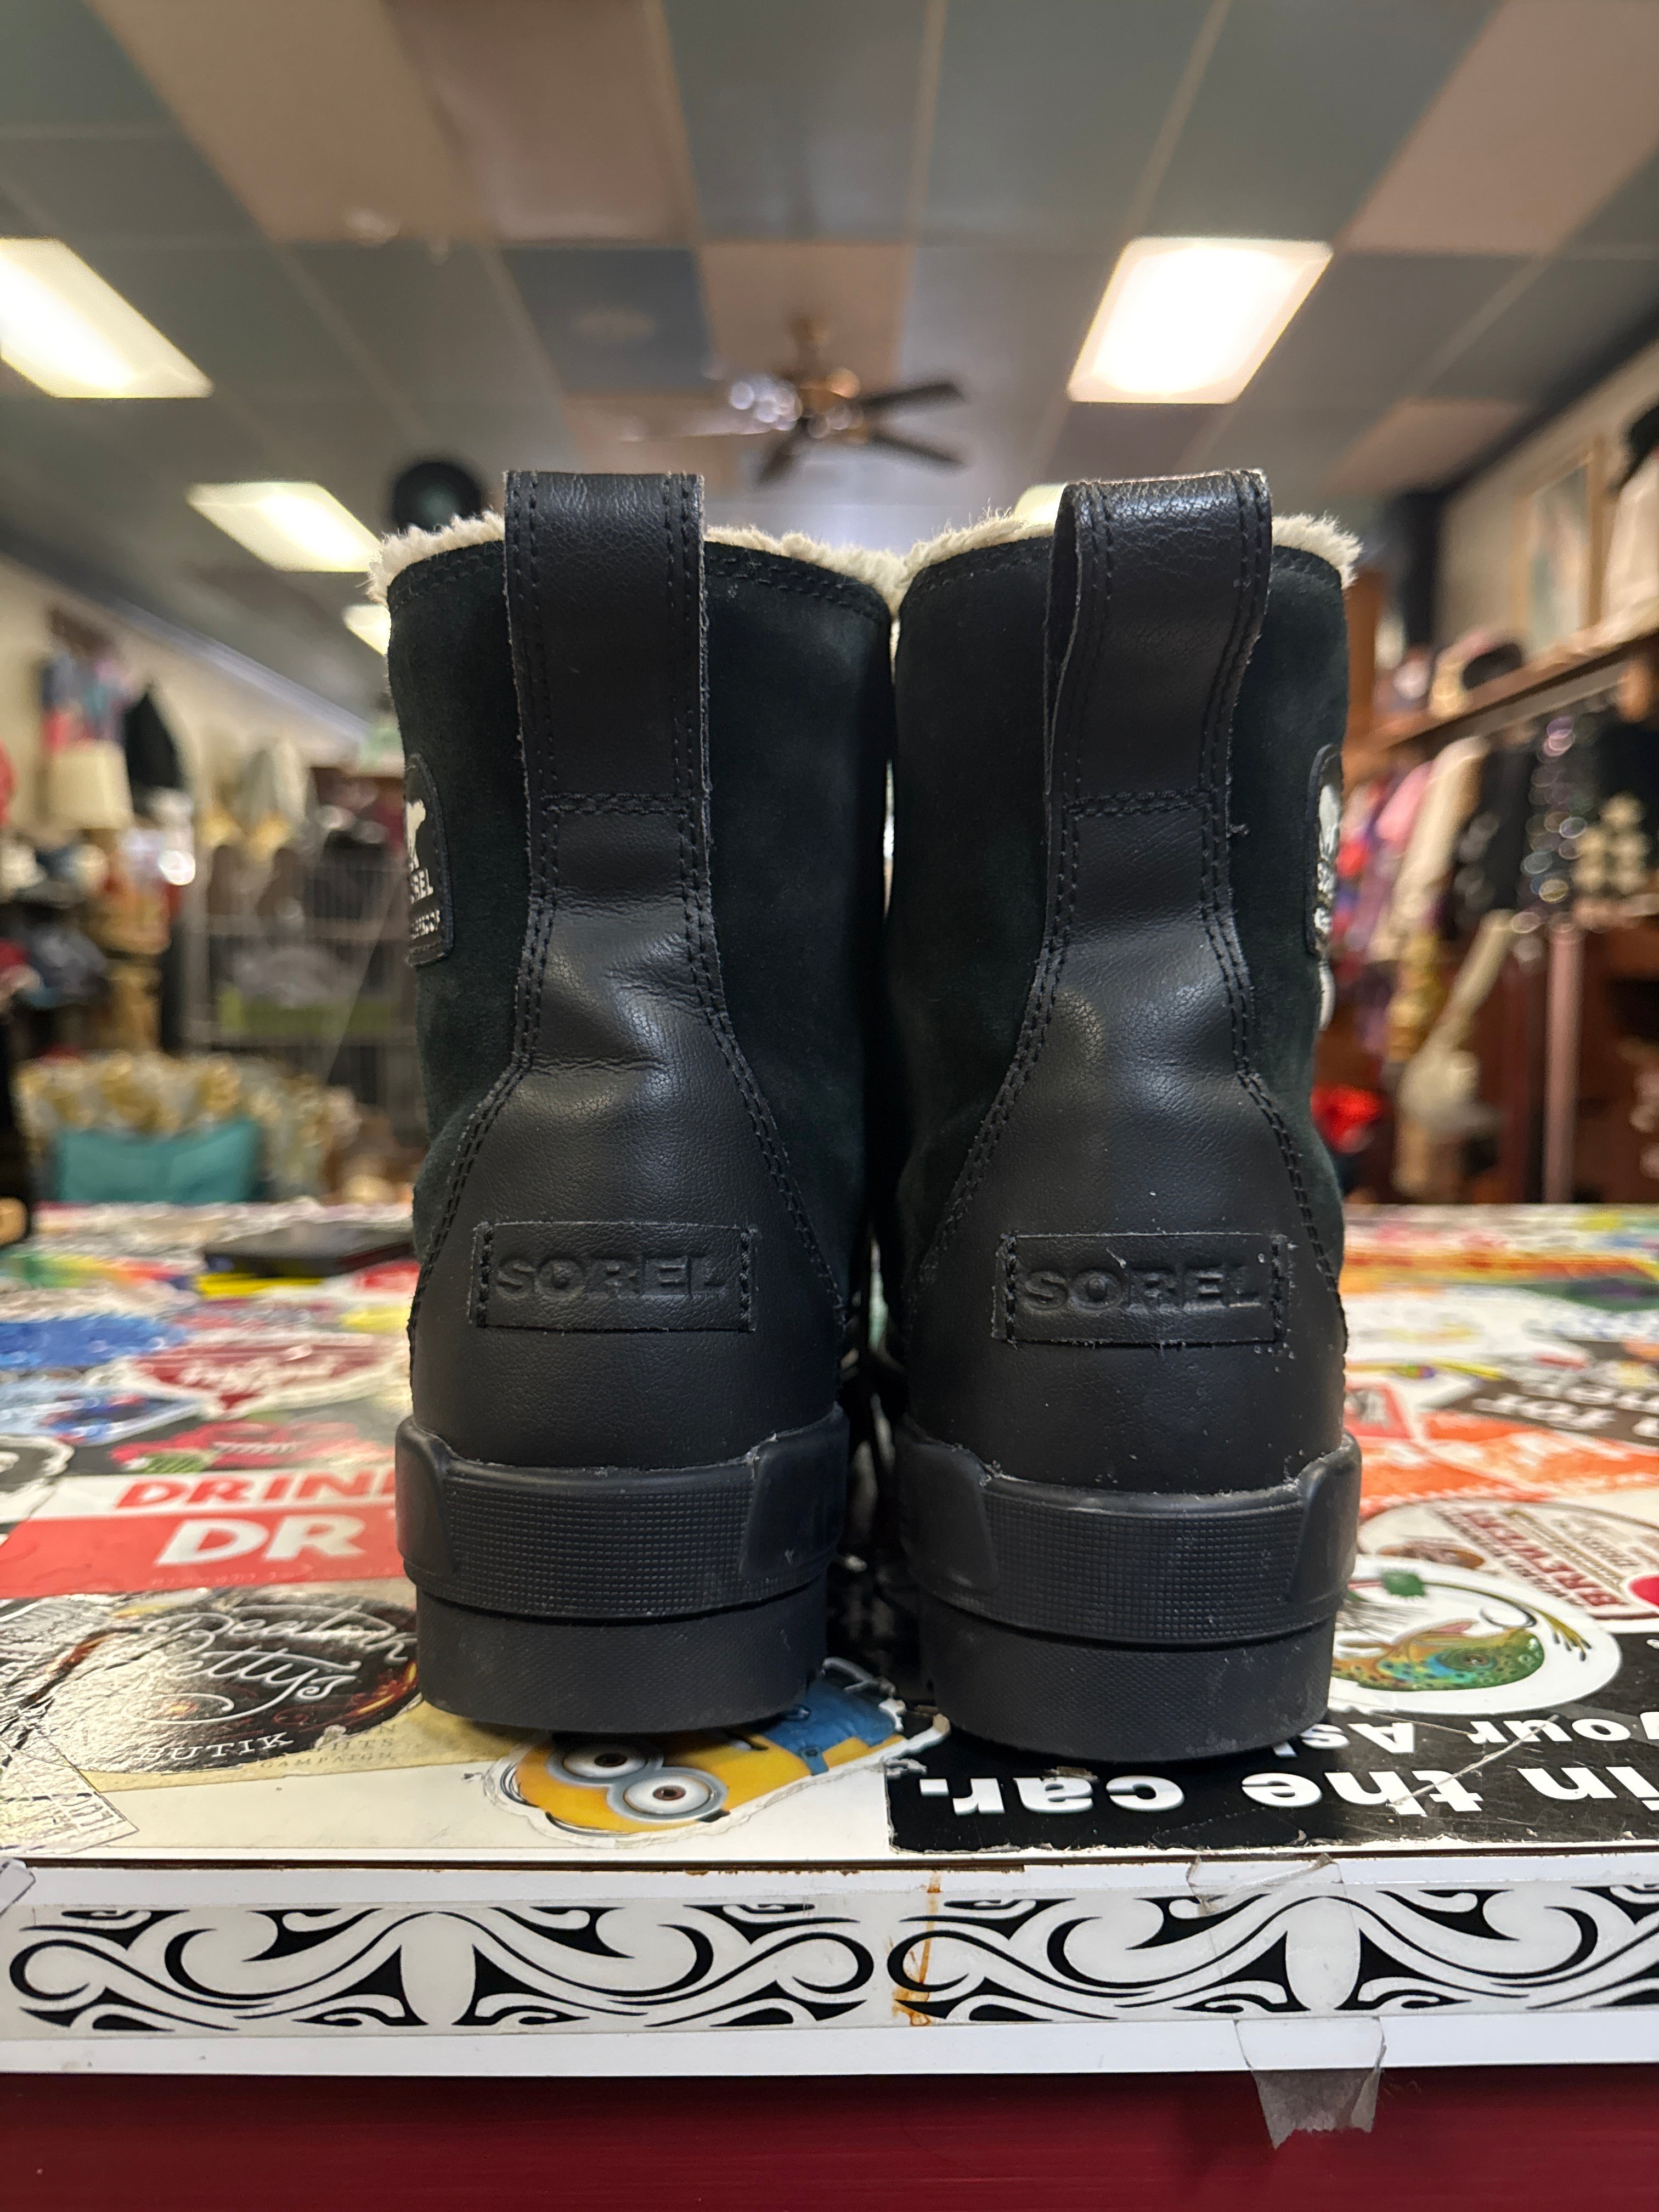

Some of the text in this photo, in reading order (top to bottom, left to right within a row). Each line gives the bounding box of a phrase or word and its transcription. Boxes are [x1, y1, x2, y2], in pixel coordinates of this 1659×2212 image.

[496, 1256, 730, 1300] SOREL
[1023, 1267, 1263, 1313] SOREL
[114, 1470, 396, 1510] DRIN
[135, 1731, 294, 1761] BUTIK
[919, 1775, 1186, 1817] car.
[1241, 1769, 1483, 1816] the
